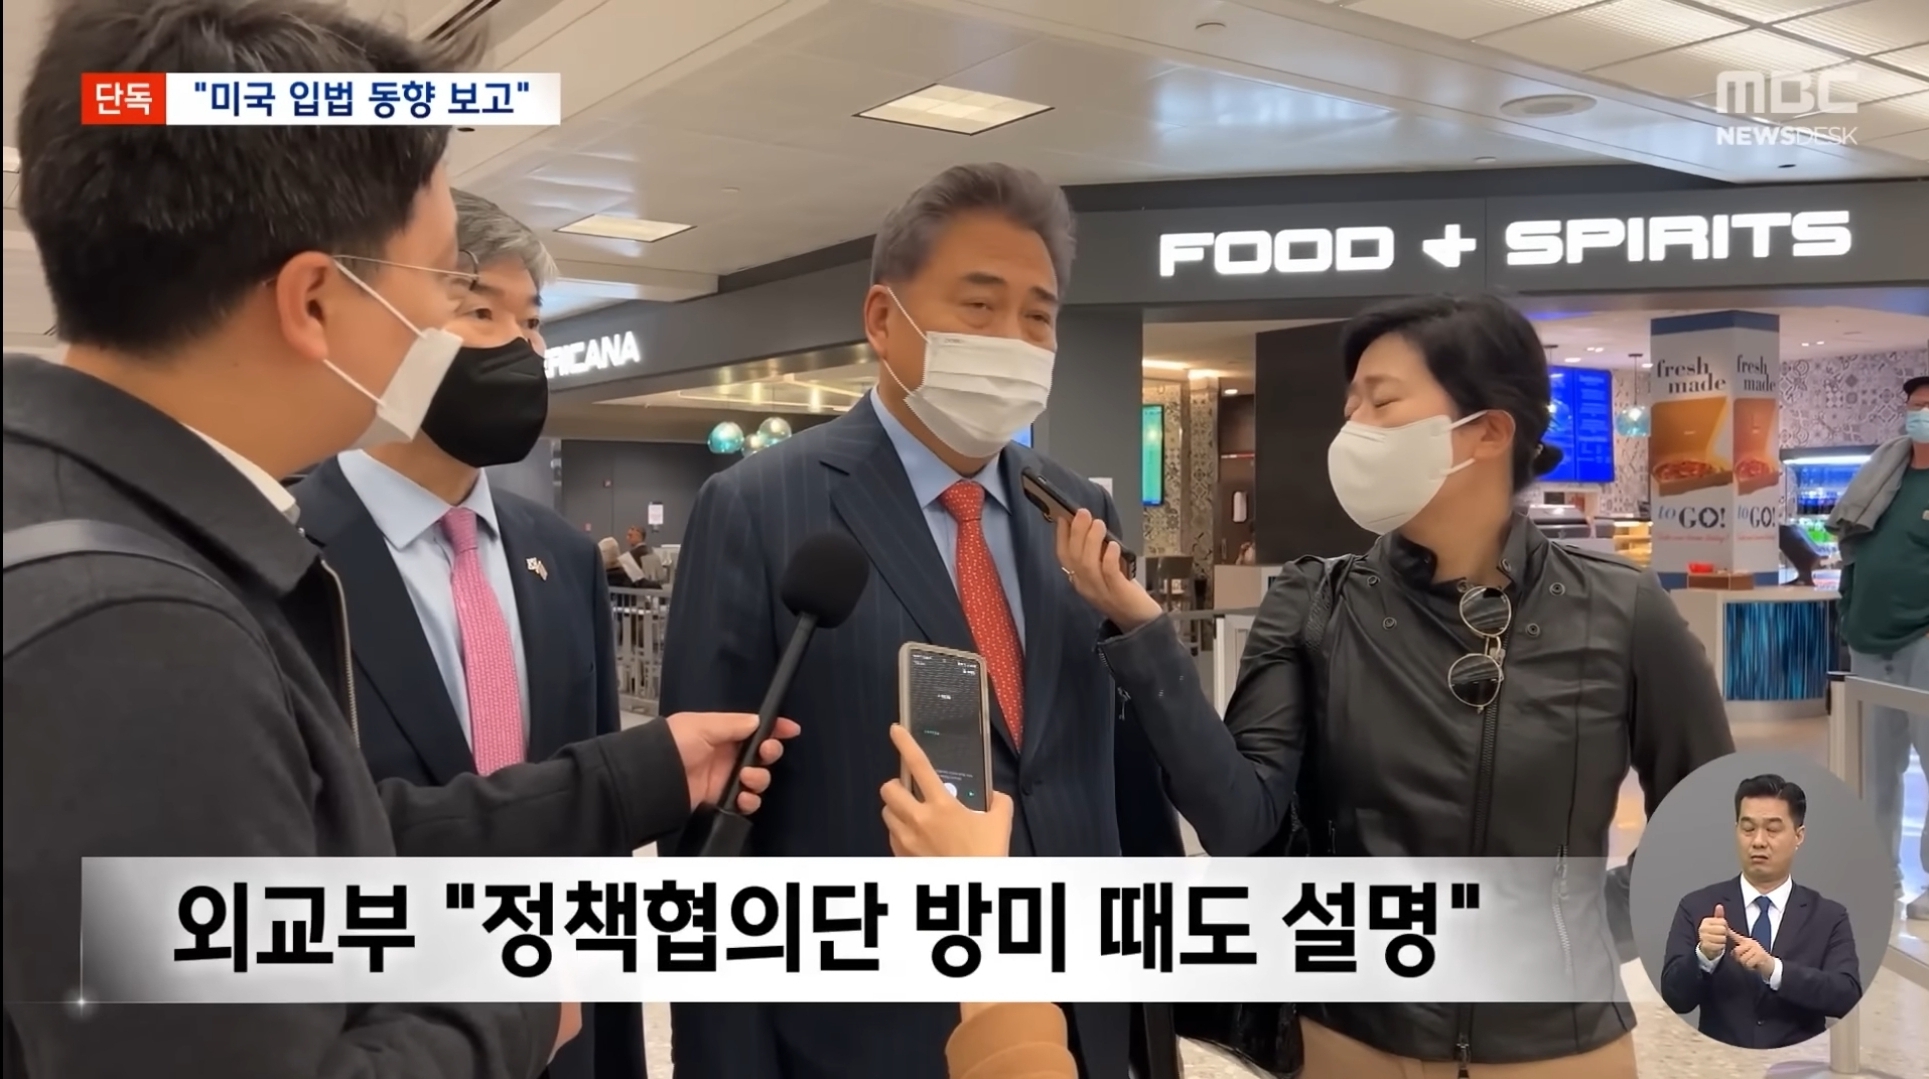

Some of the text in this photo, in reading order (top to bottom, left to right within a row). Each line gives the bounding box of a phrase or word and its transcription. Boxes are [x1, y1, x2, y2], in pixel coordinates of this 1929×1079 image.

[1159, 226, 1394, 277] FOOD
[1506, 211, 1852, 266] SPIRITS
[543, 331, 641, 379] RICANA
[1737, 354, 1768, 375] fresh
[1657, 356, 1709, 378] fresh
[1668, 373, 1727, 394] made
[1743, 374, 1776, 392] made
[1658, 505, 1726, 529] to GO!
[1750, 506, 1776, 529] GO!
